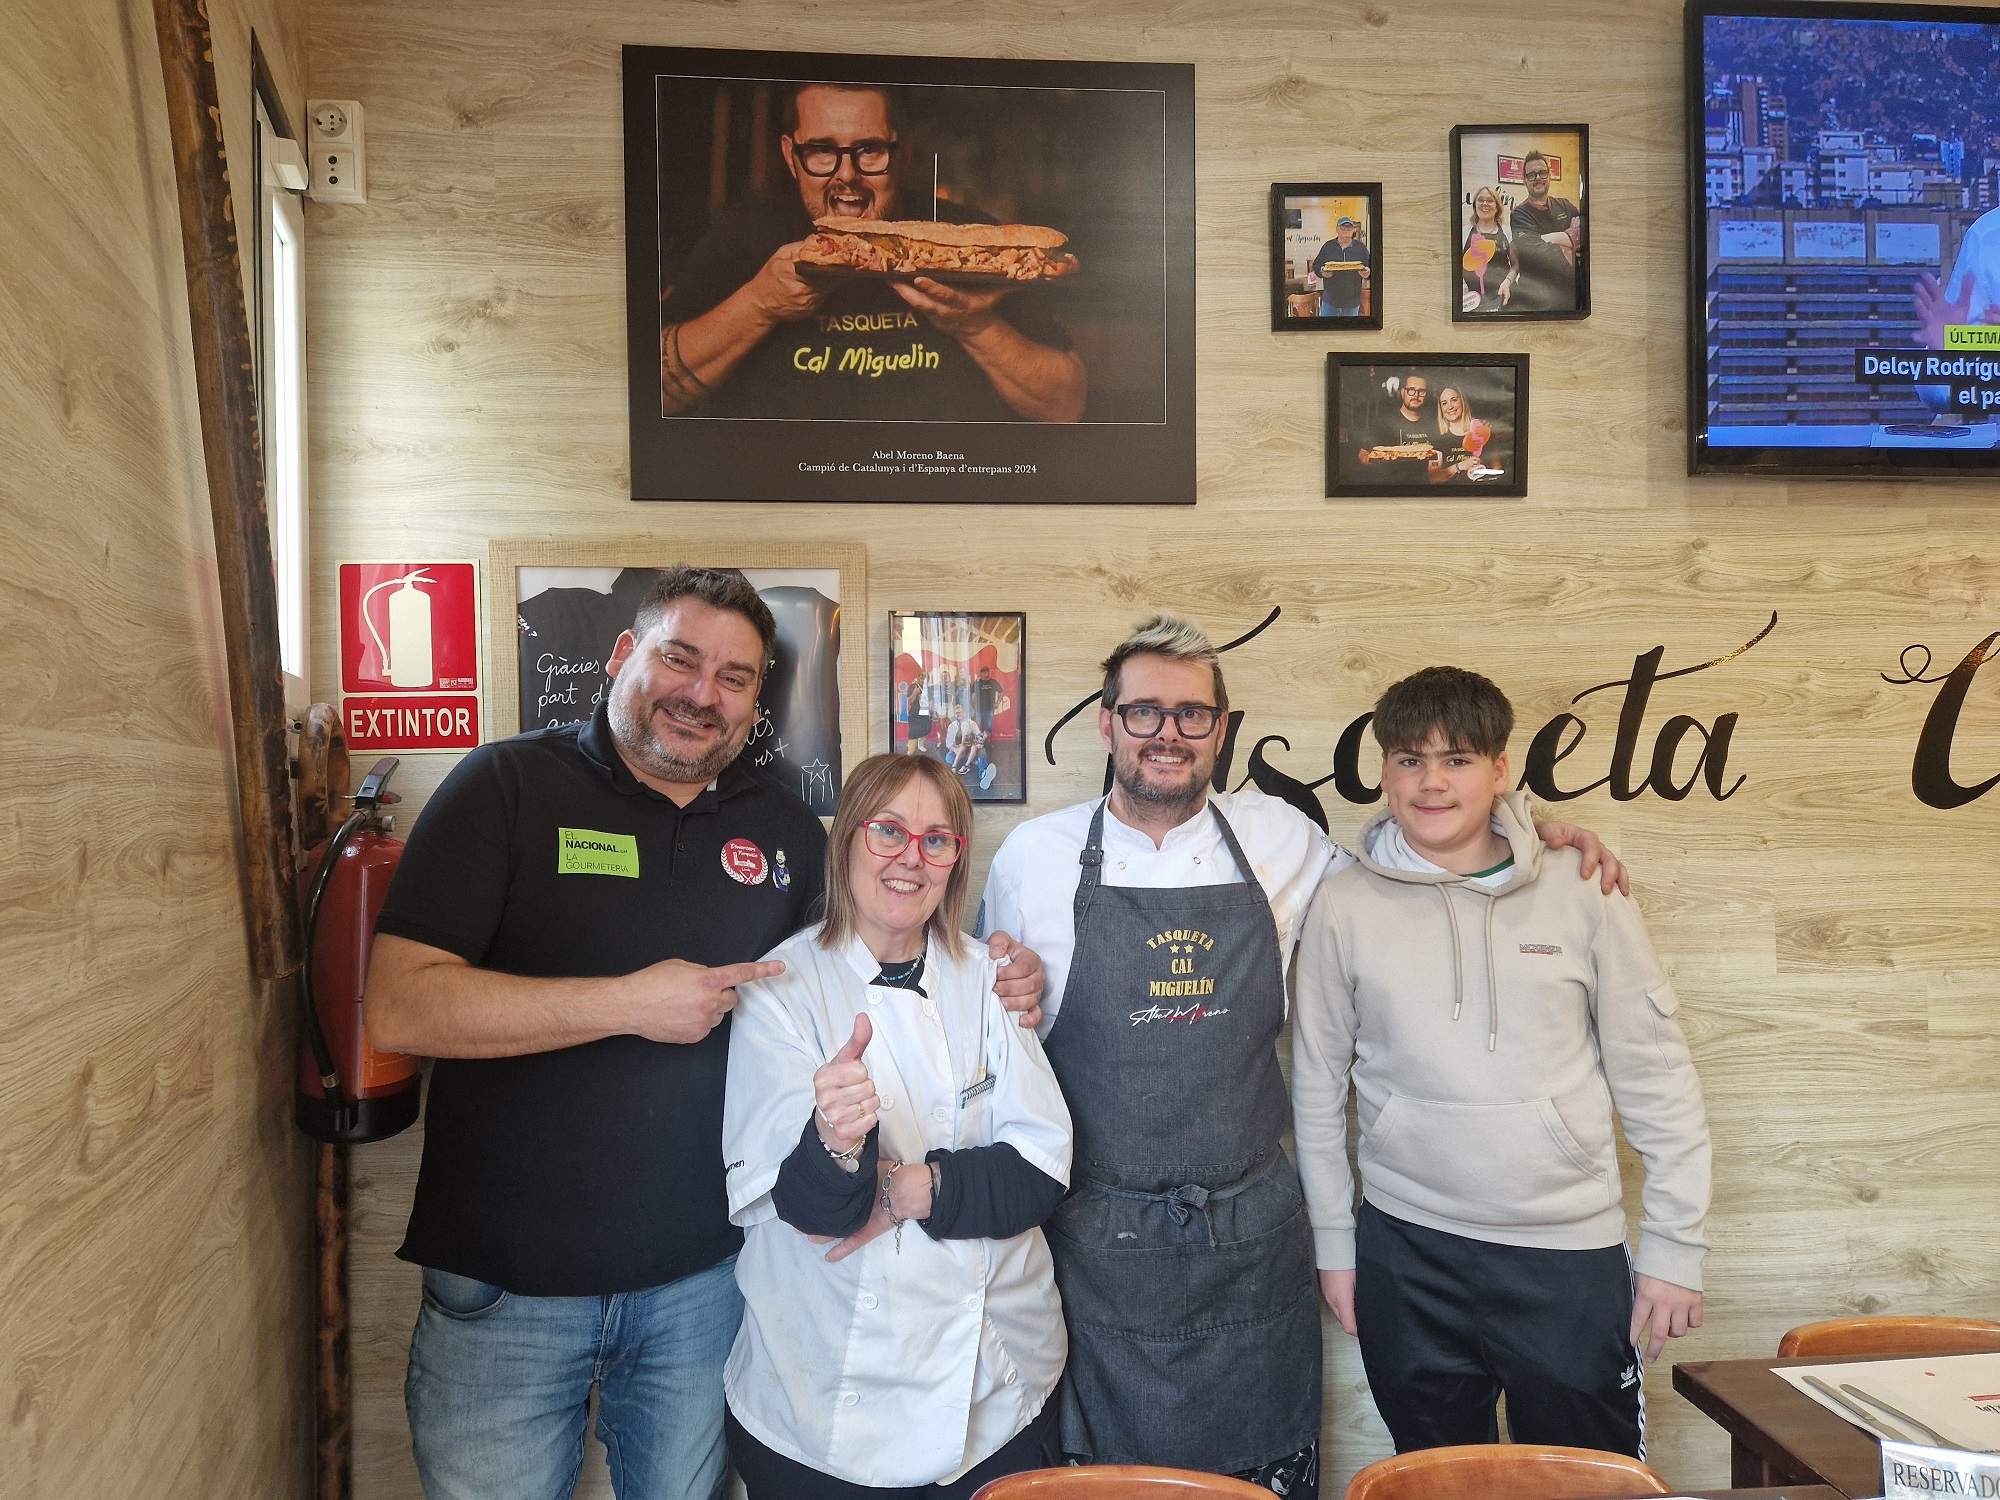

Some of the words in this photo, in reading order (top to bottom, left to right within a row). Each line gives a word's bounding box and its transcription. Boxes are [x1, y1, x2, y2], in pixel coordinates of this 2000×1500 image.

[793, 346, 831, 374] Cal
[838, 343, 940, 378] Miguelin
[1864, 356, 1922, 381] Delcy
[1958, 386, 1978, 405] el
[872, 450, 894, 460] Abel
[896, 450, 934, 460] Moreno
[935, 450, 965, 460] Baena
[798, 462, 836, 474] Campió
[838, 463, 850, 472] de
[853, 462, 900, 475] Catalunya
[902, 463, 906, 473] i
[908, 463, 956, 476] d'Espanya
[958, 464, 1012, 476] d'entrepans
[1014, 464, 1038, 474] 2024
[536, 652, 600, 693] Gràcies
[538, 681, 579, 718] part
[350, 707, 472, 738] EXTINTOR
[565, 840, 619, 853] NACIONAL
[566, 853, 578, 861] LA
[1146, 929, 1216, 952] TASQUETA
[1171, 958, 1194, 975] CAL
[1149, 976, 1215, 998] MIGUELÍN
